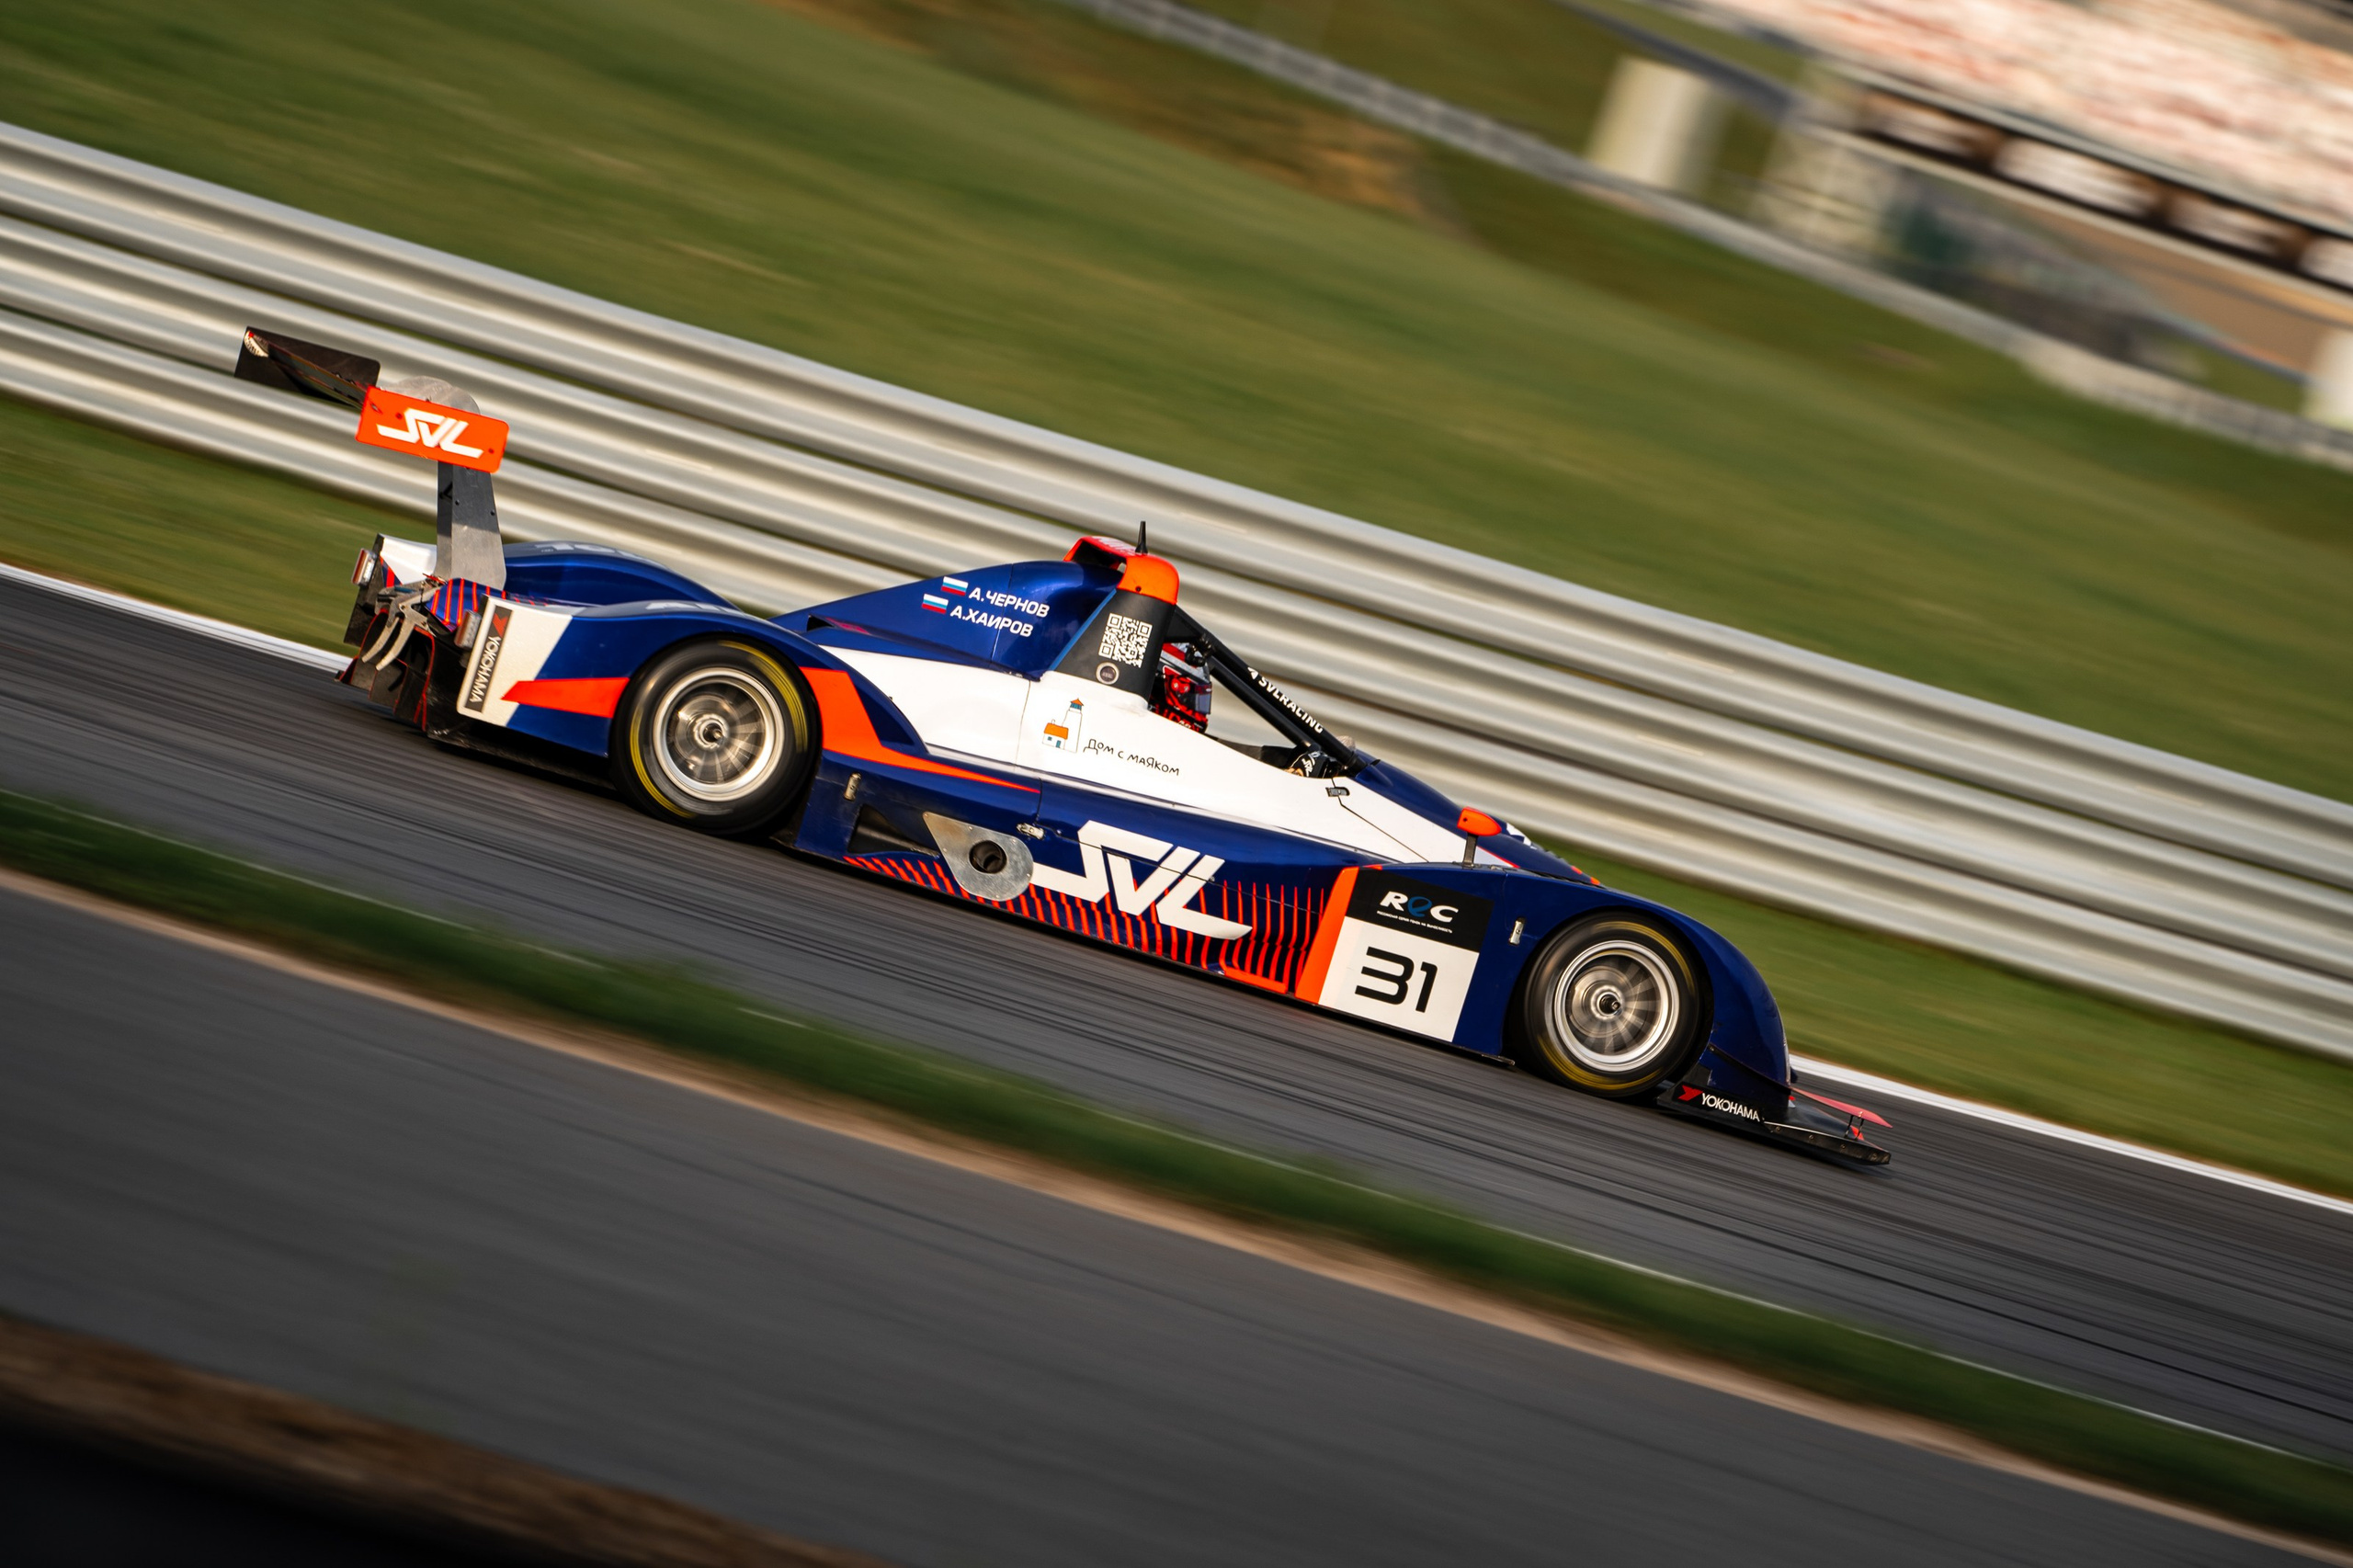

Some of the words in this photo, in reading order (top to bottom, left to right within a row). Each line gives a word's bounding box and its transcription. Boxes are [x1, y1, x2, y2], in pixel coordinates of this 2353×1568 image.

[968, 587, 1050, 618] А.ЧЕРНОВ
[949, 605, 1034, 637] А.ХАИРОВ
[470, 636, 501, 703] YOKOHAMA
[1355, 946, 1438, 1013] 31
[1701, 1092, 1760, 1122] YOKOHAMA
